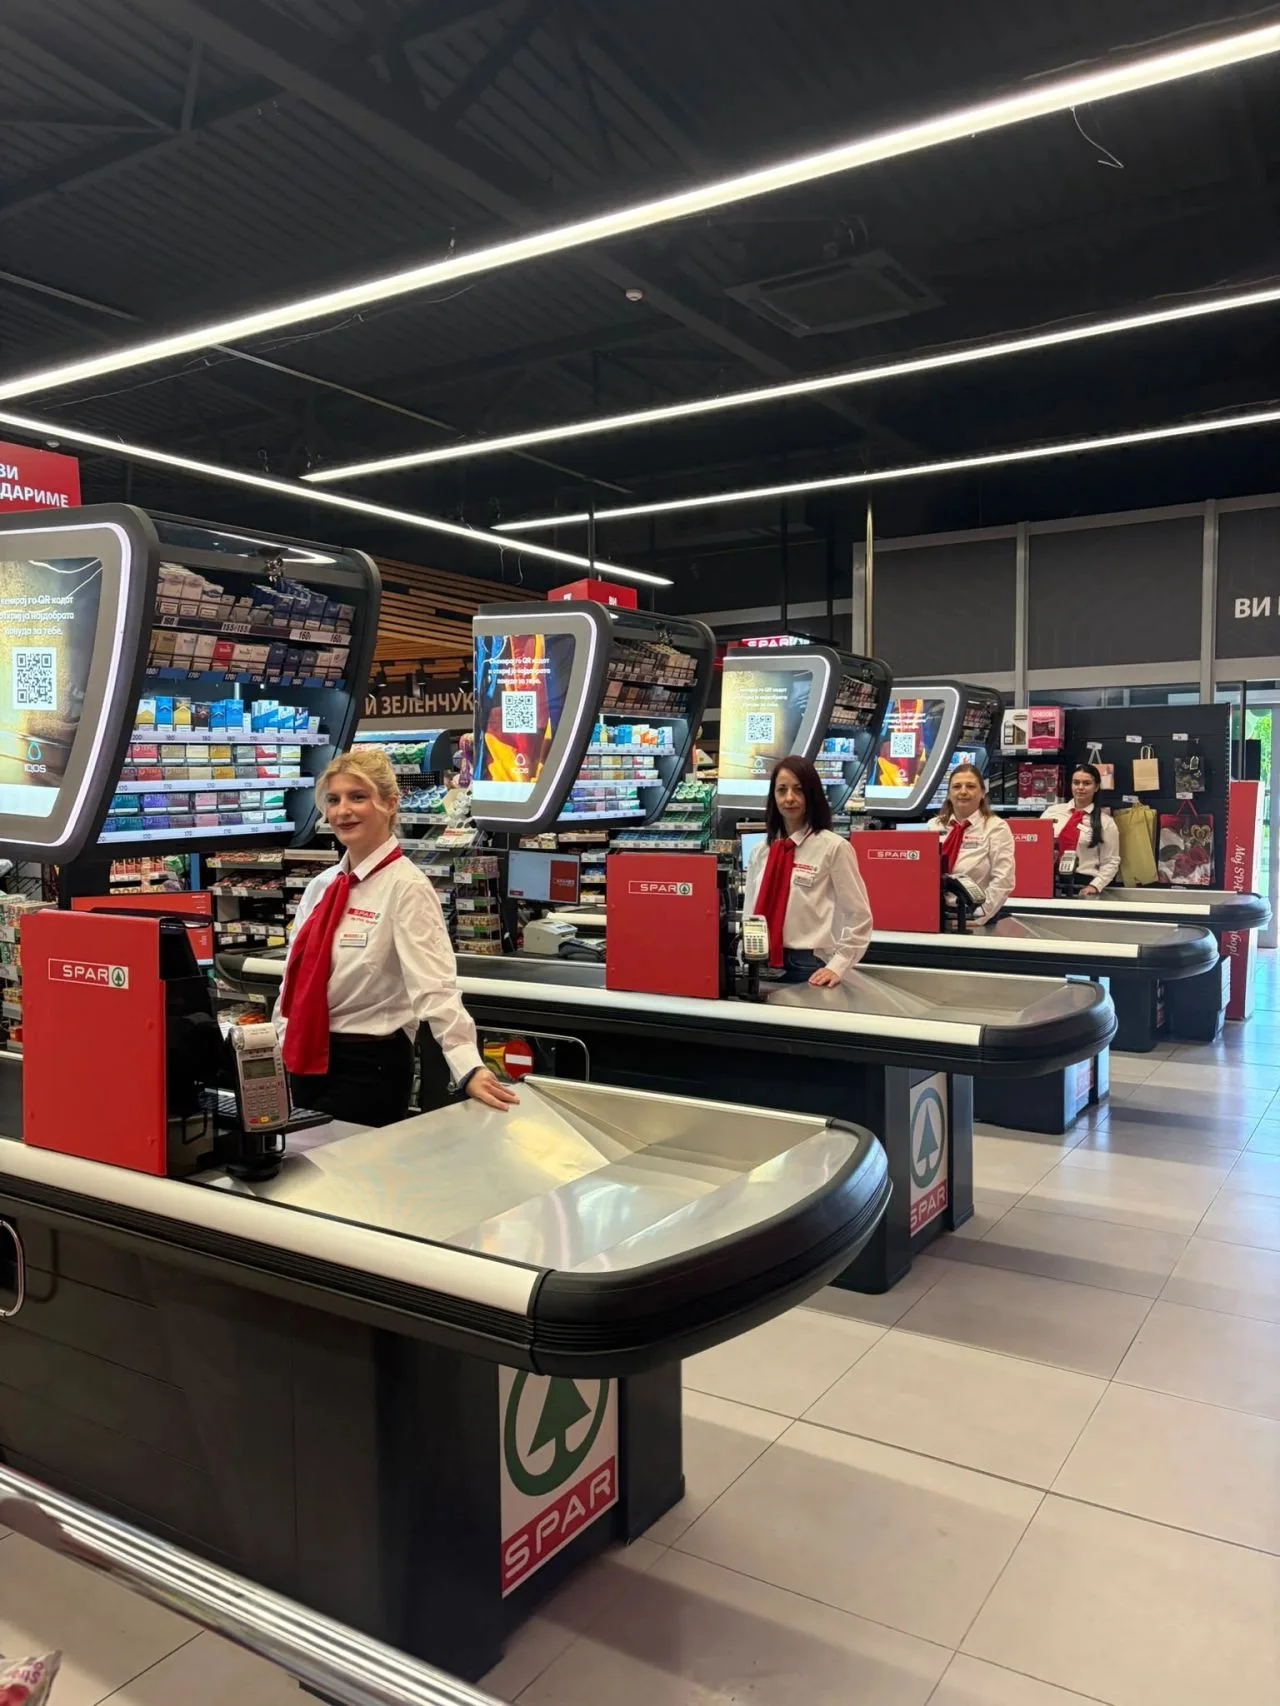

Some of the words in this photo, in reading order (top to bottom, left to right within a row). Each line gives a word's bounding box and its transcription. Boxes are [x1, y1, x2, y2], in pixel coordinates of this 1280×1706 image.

[0, 483, 69, 508] ДАРИМЕ
[38, 595, 50, 604] QR
[1235, 597, 1270, 618] ВИ
[365, 698, 377, 715] И
[381, 692, 474, 714] ЗЕЛЕНЧУК
[24, 764, 46, 774] IQOS
[877, 850, 907, 859] SPAR
[1231, 844, 1246, 864] Мој
[640, 883, 677, 893] SPAR
[1233, 867, 1245, 892] SPA
[62, 964, 108, 982] SPAR
[910, 1185, 946, 1229] SPAR
[505, 1468, 611, 1579] SPAR
